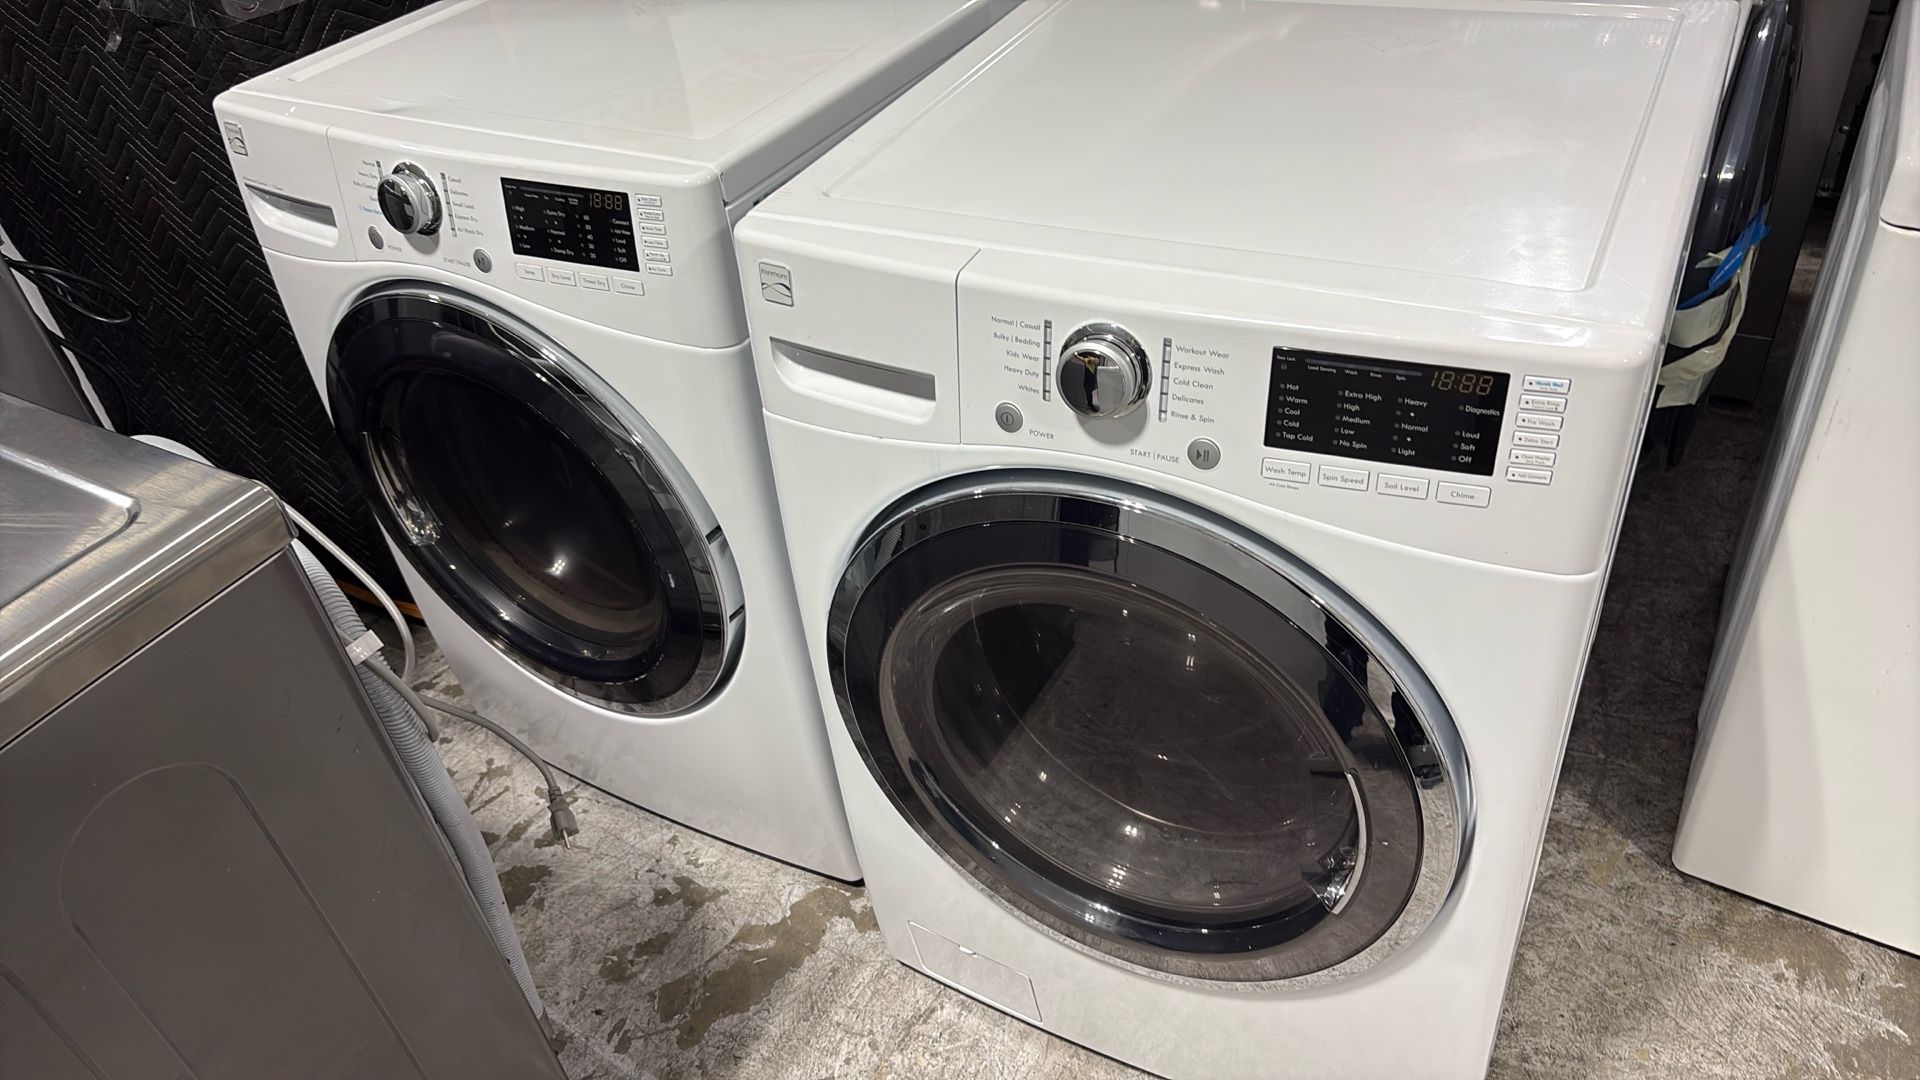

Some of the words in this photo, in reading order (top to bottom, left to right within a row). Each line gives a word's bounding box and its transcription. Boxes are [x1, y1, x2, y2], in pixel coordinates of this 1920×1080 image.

[991, 316, 1014, 327] Normal
[1019, 321, 1041, 331] Casual
[993, 332, 1010, 342] Bulky
[1014, 337, 1041, 348] Bedding
[1006, 350, 1020, 359] Kids
[1022, 352, 1040, 362] Wear
[1175, 345, 1207, 356] Workout
[1208, 349, 1230, 359] Wear
[1003, 365, 1024, 376] Heavy
[1024, 367, 1040, 379] Duty
[1174, 362, 1201, 372] Express
[1203, 366, 1225, 376] Wash
[1173, 377, 1190, 387] Cold
[1192, 380, 1214, 390] Clean
[1286, 383, 1299, 391] Hot
[1017, 384, 1040, 395] Whites
[1171, 393, 1204, 405] Delicates
[1285, 395, 1308, 405] Warm
[1344, 390, 1363, 399] Extra
[1365, 393, 1382, 402] High
[1343, 402, 1360, 412] High
[1404, 397, 1428, 408] Heavy
[1284, 407, 1300, 416] Cool
[1465, 404, 1500, 417] Diagnostics
[1171, 410, 1189, 420] Rinse
[1198, 415, 1215, 424] Spin
[1341, 415, 1371, 425] Medium
[1283, 419, 1300, 428] Cold
[1401, 422, 1429, 433] Normal
[1538, 419, 1556, 428] Wash
[1029, 429, 1055, 440] POWER
[1282, 431, 1296, 440] Tap
[1296, 433, 1314, 442] Cold
[1340, 427, 1355, 435] Low
[1462, 430, 1481, 440] Loud
[1339, 439, 1350, 447] No
[1352, 440, 1367, 449] Spin
[1460, 443, 1476, 452] Soft
[1130, 448, 1151, 458] START
[1156, 453, 1180, 464] PAUSE
[1397, 447, 1416, 457] Light
[1458, 455, 1473, 464] Off
[1265, 465, 1286, 476] Wash
[1287, 467, 1307, 478] Temp
[1322, 473, 1339, 483] Spin
[1340, 475, 1365, 486] Speed
[1384, 481, 1398, 490] Soil
[1399, 483, 1420, 493] Level
[1450, 490, 1475, 500] Chime
